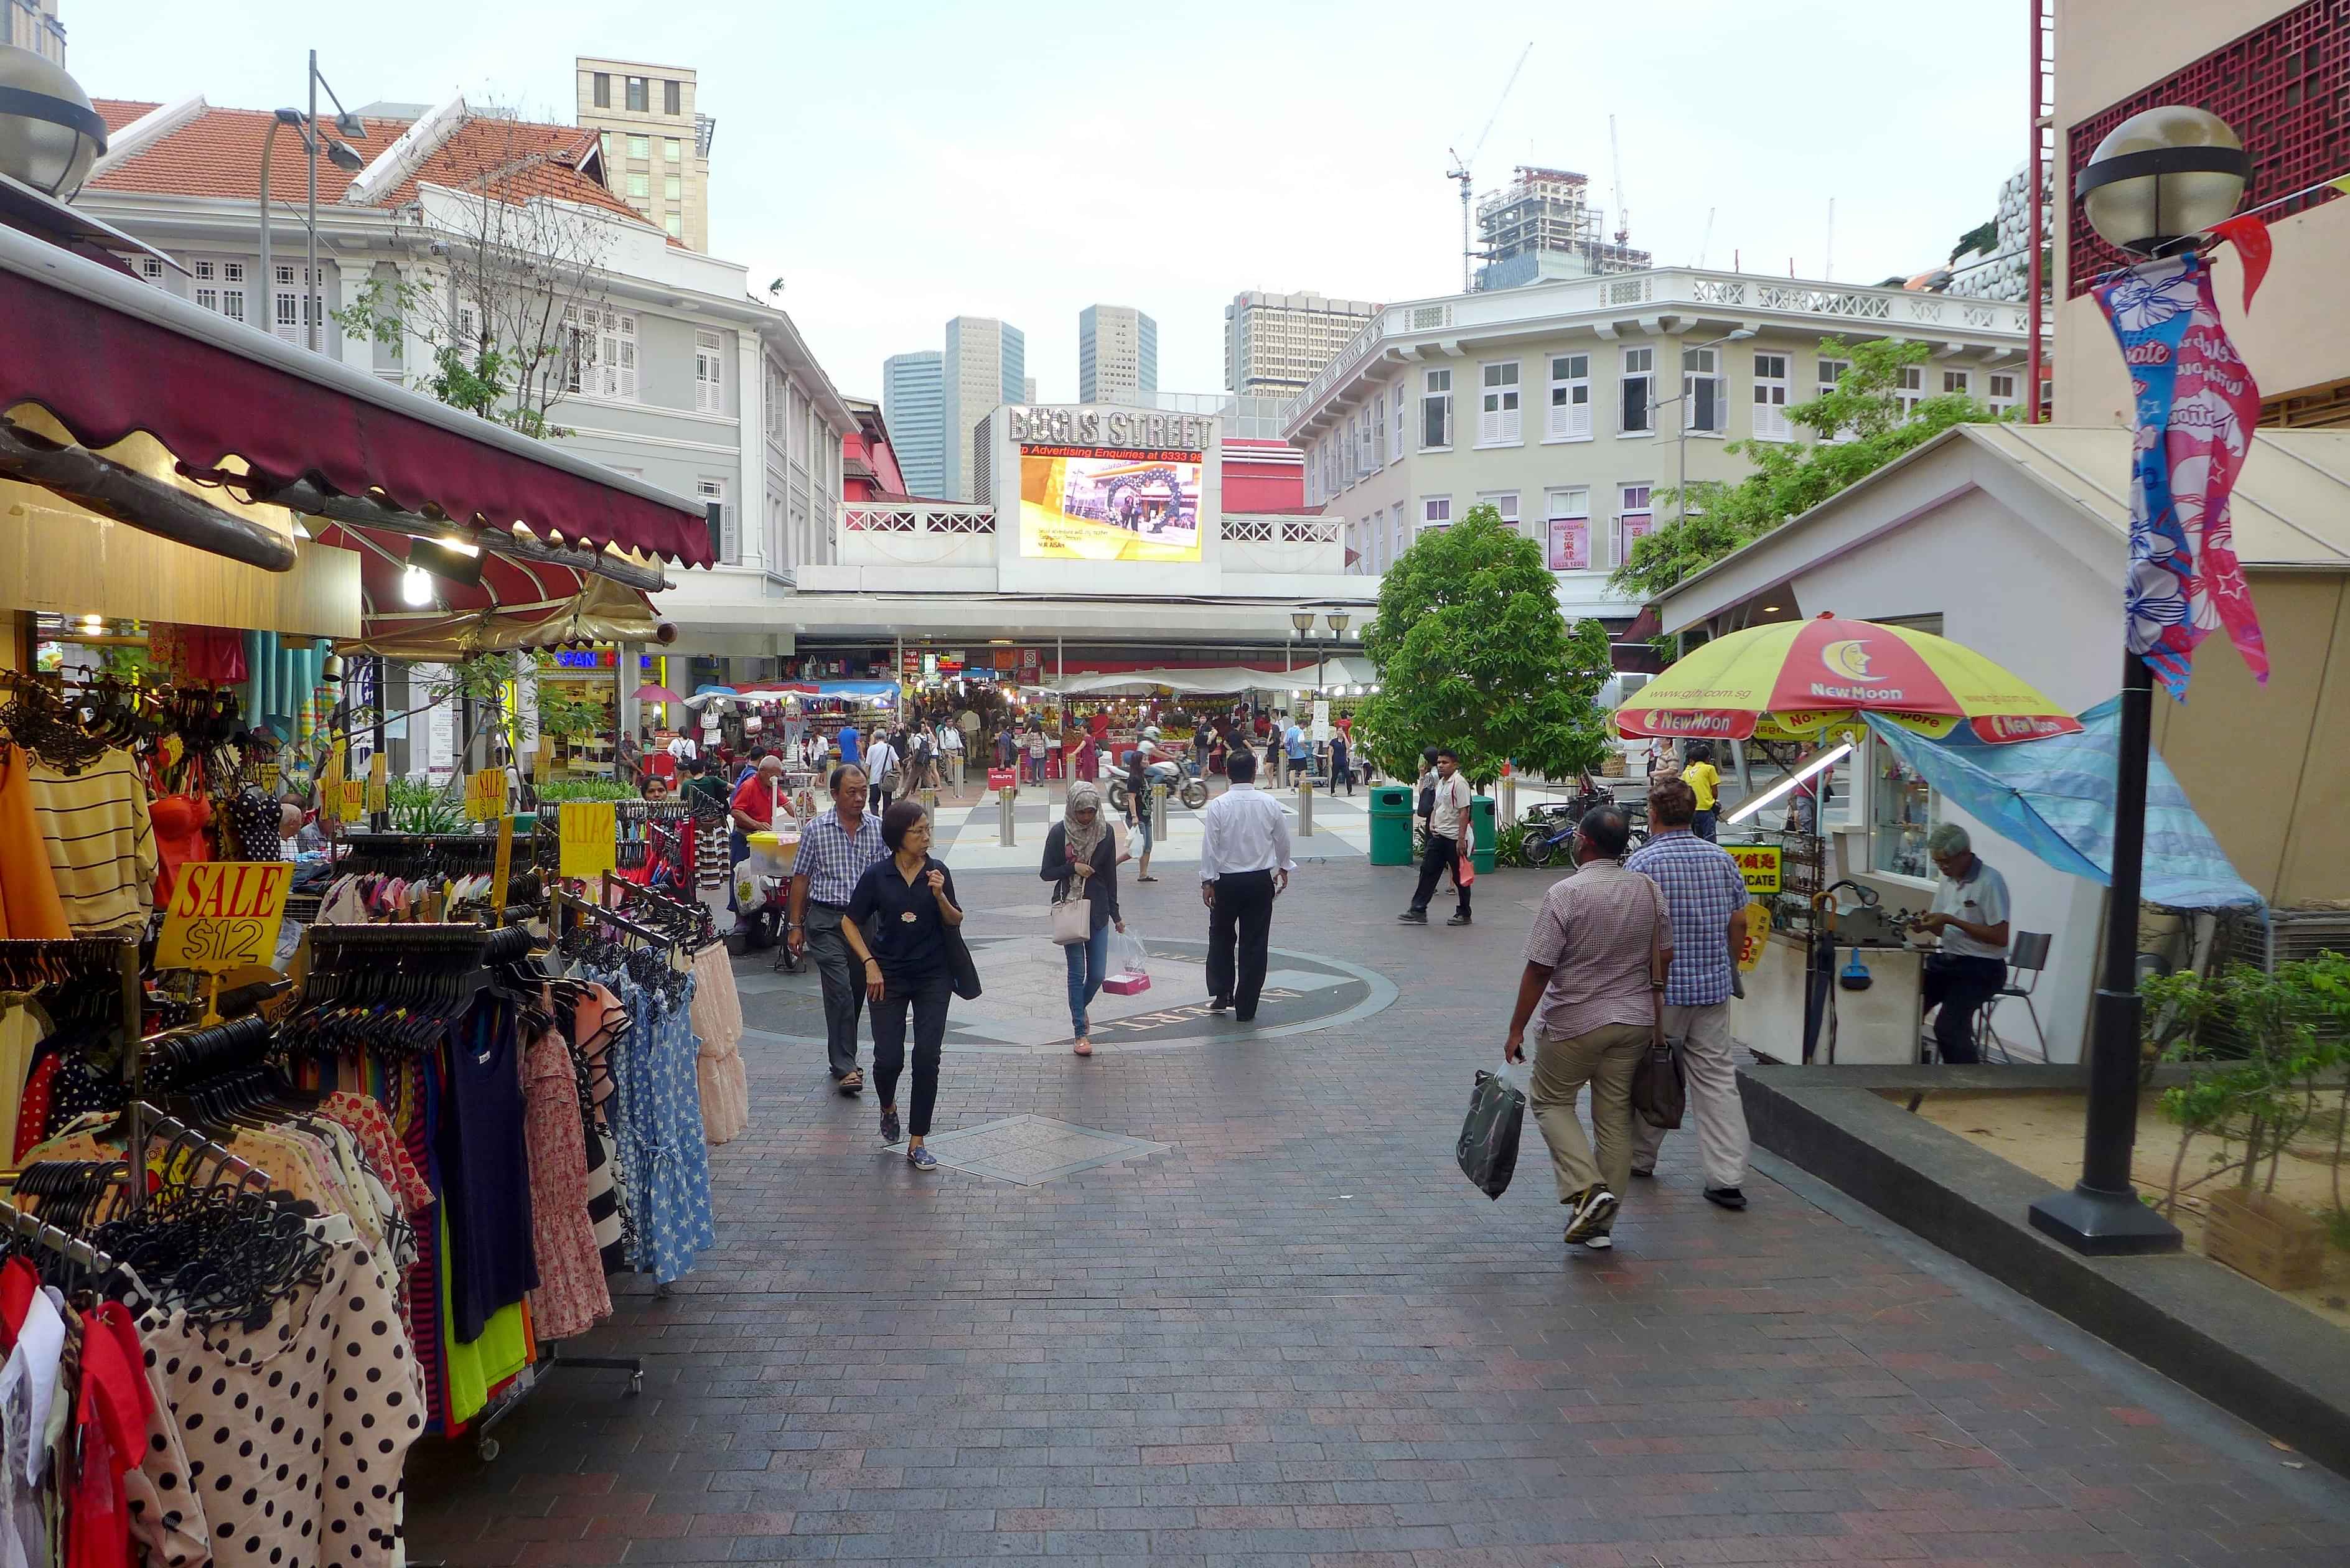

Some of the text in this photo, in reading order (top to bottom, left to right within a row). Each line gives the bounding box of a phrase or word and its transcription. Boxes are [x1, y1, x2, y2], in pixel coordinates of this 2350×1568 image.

[1010, 407, 1213, 449] BUGIS STREET
[1031, 445, 1092, 458] Advertising
[1095, 448, 1145, 459] Enquiries
[1161, 451, 1187, 461] 6333
[479, 771, 500, 798] SALE
[178, 865, 283, 918] SALE
[1744, 875, 1776, 886] ICATE
[182, 918, 264, 963] $12
